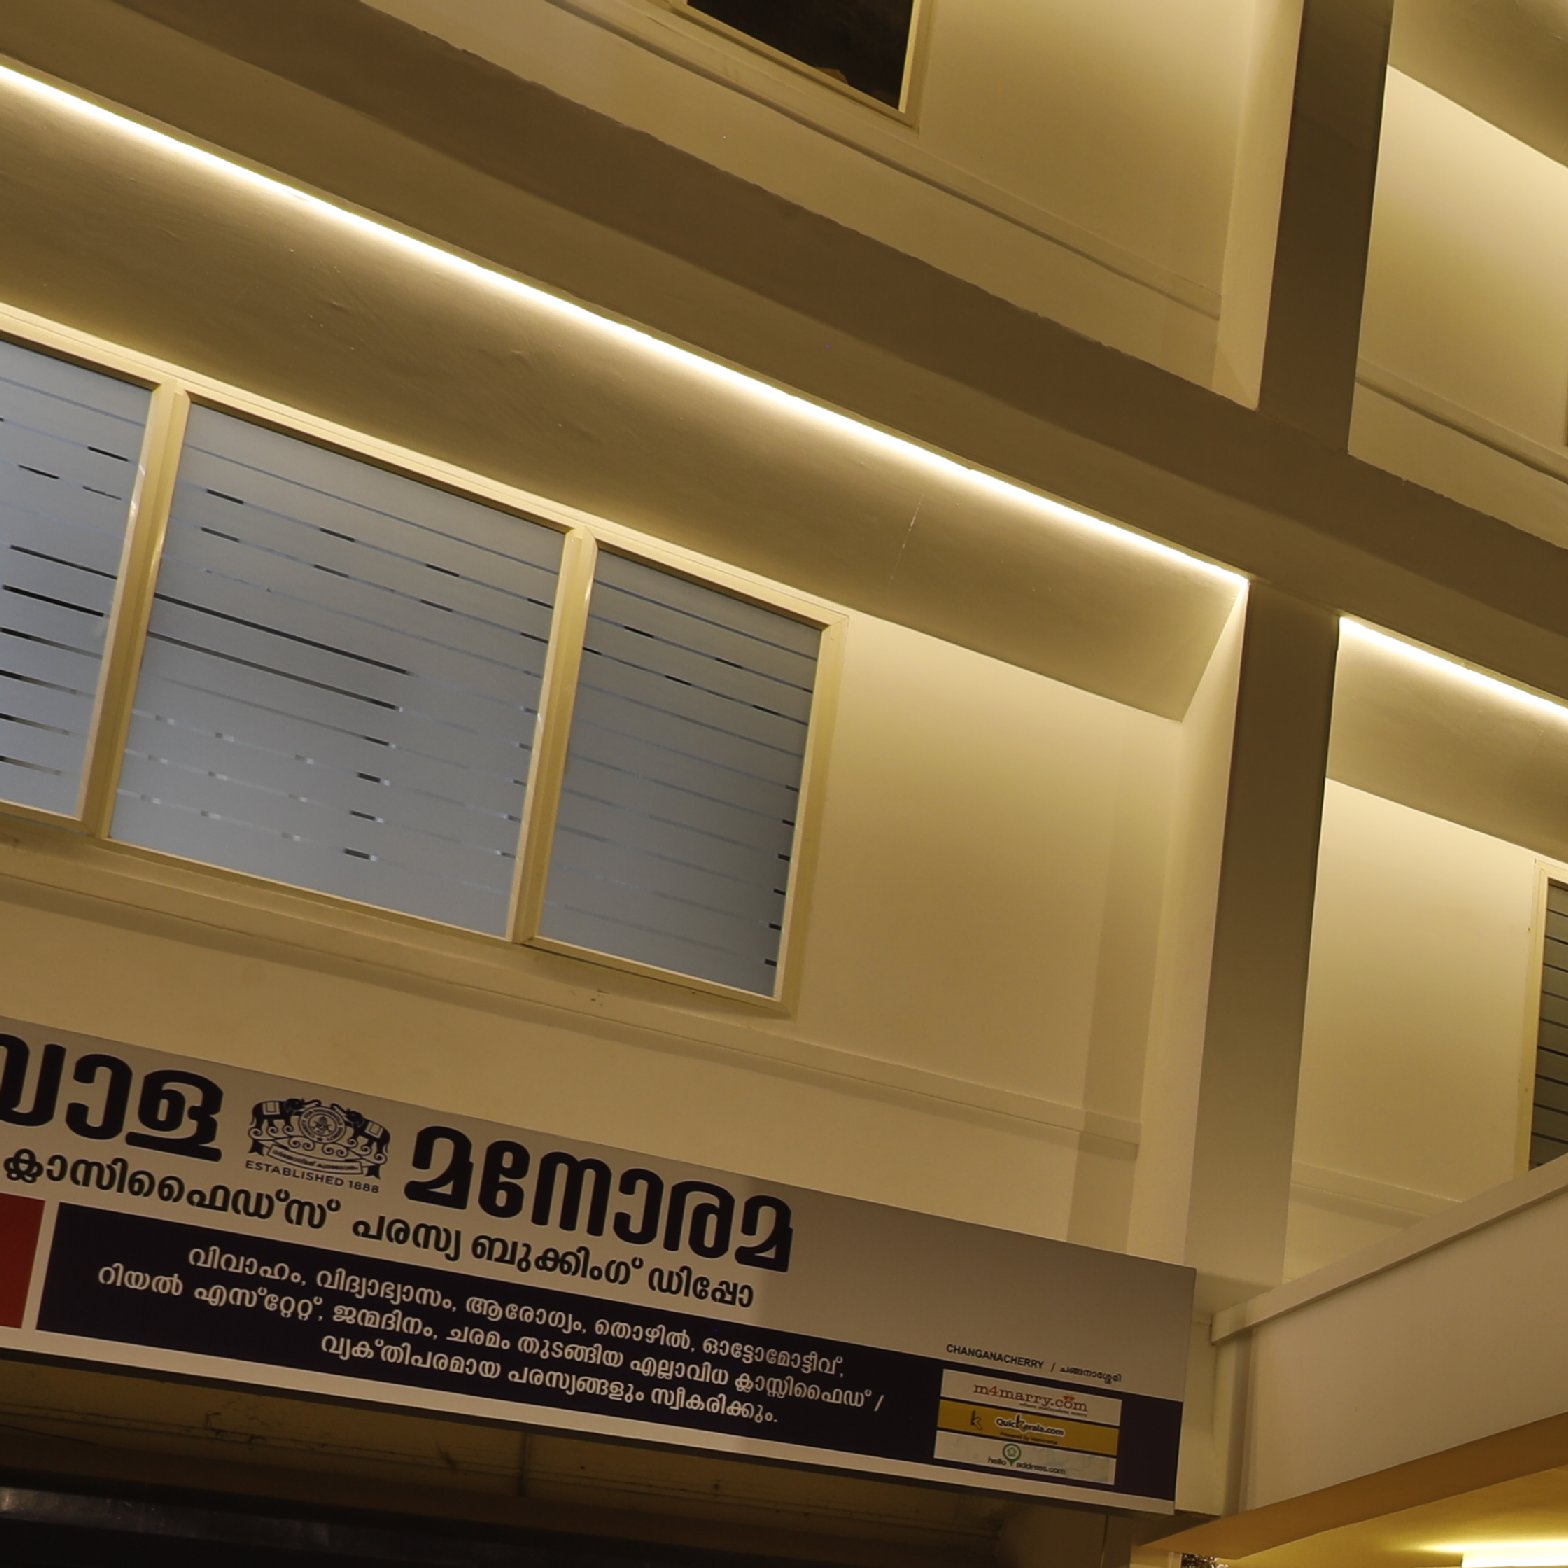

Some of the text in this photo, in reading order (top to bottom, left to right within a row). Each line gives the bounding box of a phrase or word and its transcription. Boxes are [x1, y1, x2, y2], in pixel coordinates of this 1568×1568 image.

[245, 1159, 344, 1187] ESTABLISHED
[349, 1180, 379, 1194] 1888
[404, 1125, 793, 1273] മനോരമ
[188, 1245, 306, 1287] വിവാഹം,
[352, 1215, 461, 1262] പരസ്യ
[648, 1265, 755, 1308] ഡിപ്പോ
[98, 1263, 183, 1296] റിയൽ
[446, 1326, 511, 1351] ചരമം
[517, 1335, 624, 1369] തുടങ്ങിയ
[629, 1357, 729, 1386] എല്ലാവിധ
[946, 1344, 1044, 1369] CHANGANACHERRY
[508, 1367, 645, 1404] പരസ്യങ്ങളും
[973, 1383, 1088, 1413] m4marry.com
